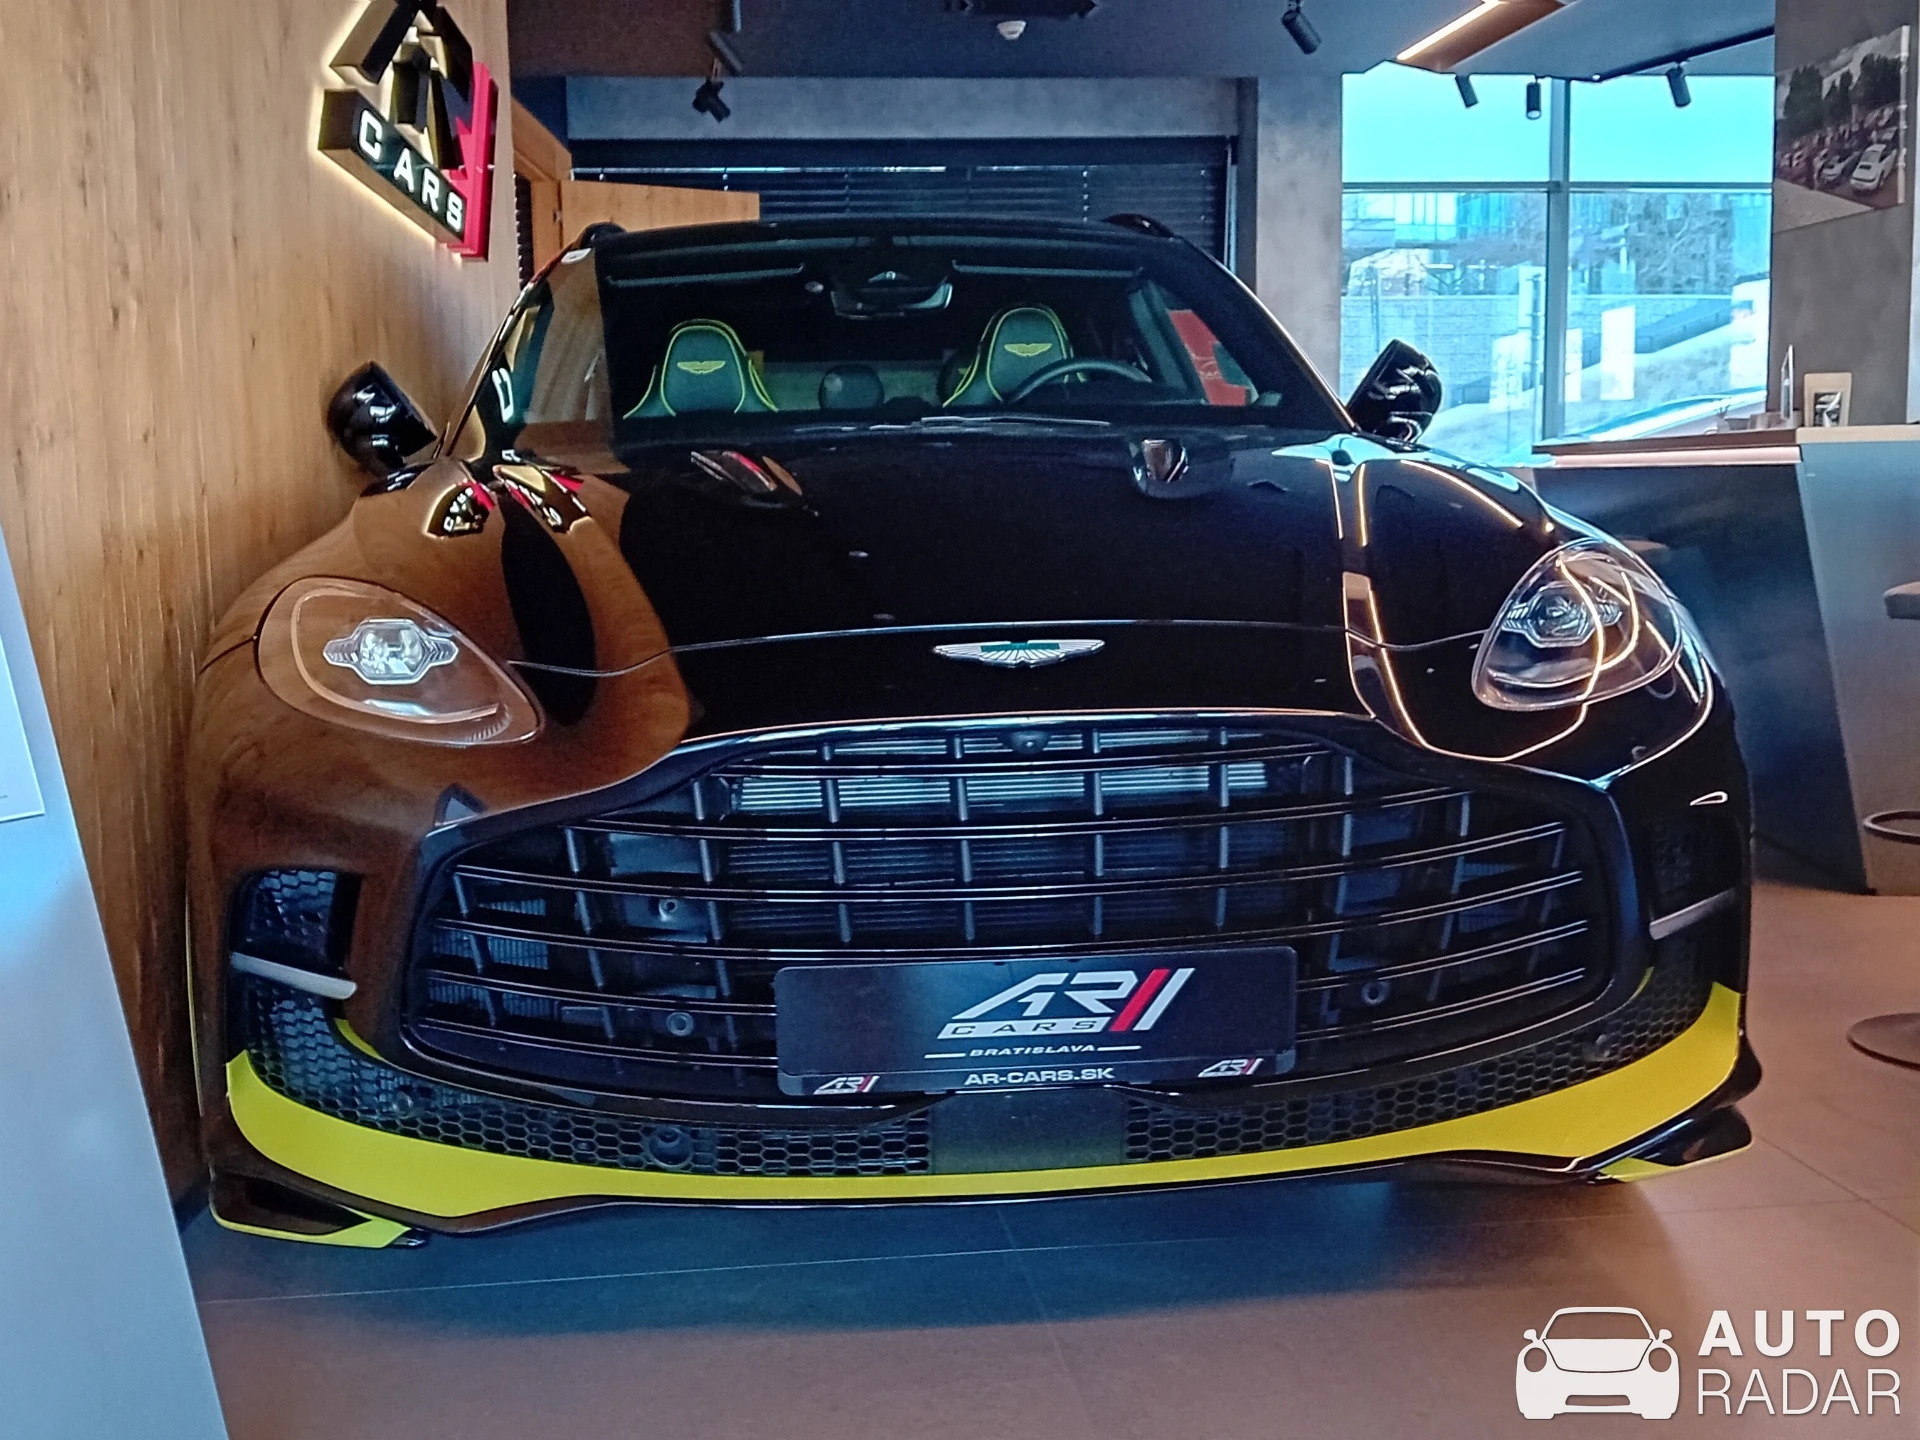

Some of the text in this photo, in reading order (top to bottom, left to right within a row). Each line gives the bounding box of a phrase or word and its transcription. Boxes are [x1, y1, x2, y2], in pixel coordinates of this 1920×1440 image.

[358, 108, 463, 232] CARS
[951, 1019, 1097, 1037] CARS
[968, 1044, 1096, 1058] BRATISLAVA
[964, 1067, 1116, 1087] AR-CARS.SK
